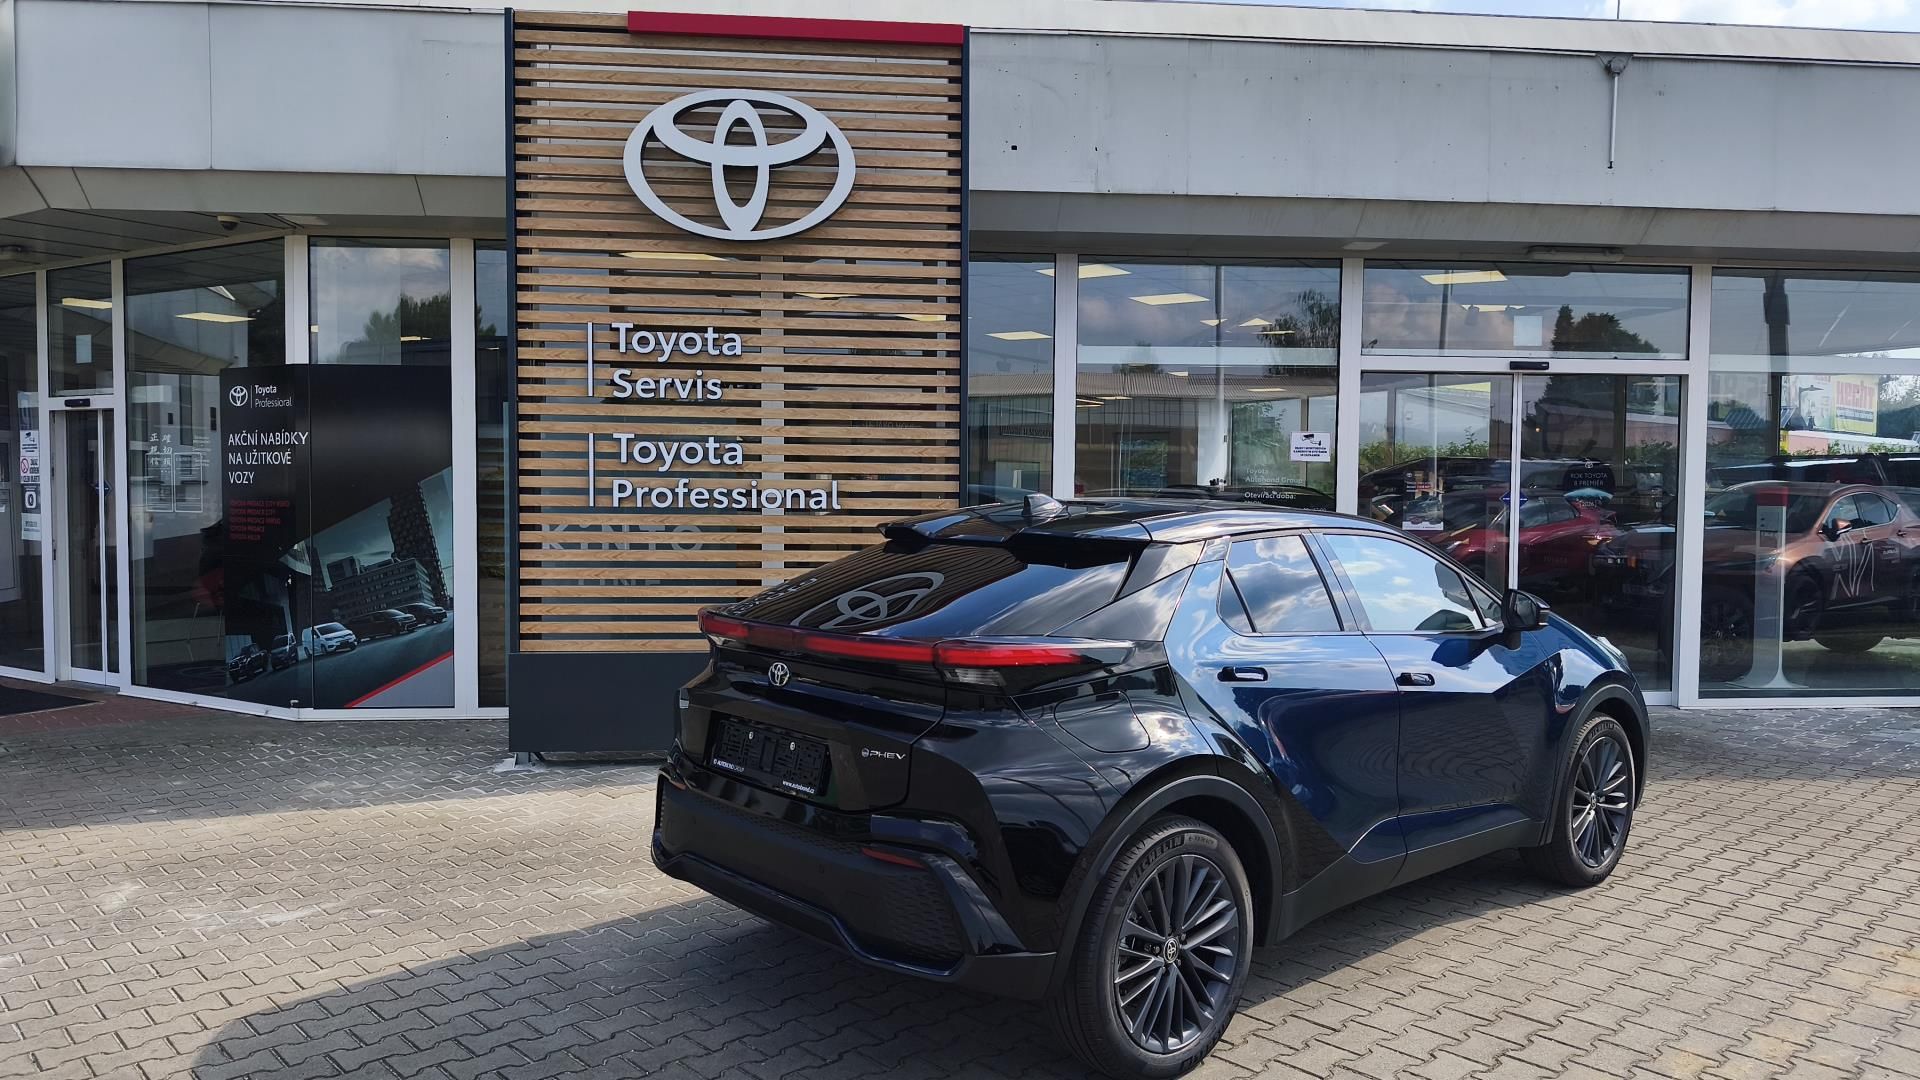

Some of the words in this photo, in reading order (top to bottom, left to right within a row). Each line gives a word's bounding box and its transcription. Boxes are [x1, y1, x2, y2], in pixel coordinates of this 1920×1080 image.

[611, 322, 743, 363] Toyota
[254, 384, 277, 396] Toyota
[612, 369, 723, 400] Servis
[254, 396, 293, 408] Professional
[228, 429, 258, 446] AKČNÍ
[260, 428, 309, 446] NABÍDKY
[228, 452, 243, 465] NA
[245, 448, 292, 465] UŽITKOVÉ
[612, 432, 743, 472] Toyota
[228, 471, 255, 484] VOZY
[612, 478, 842, 510] Professional
[869, 750, 906, 760] PHEV
